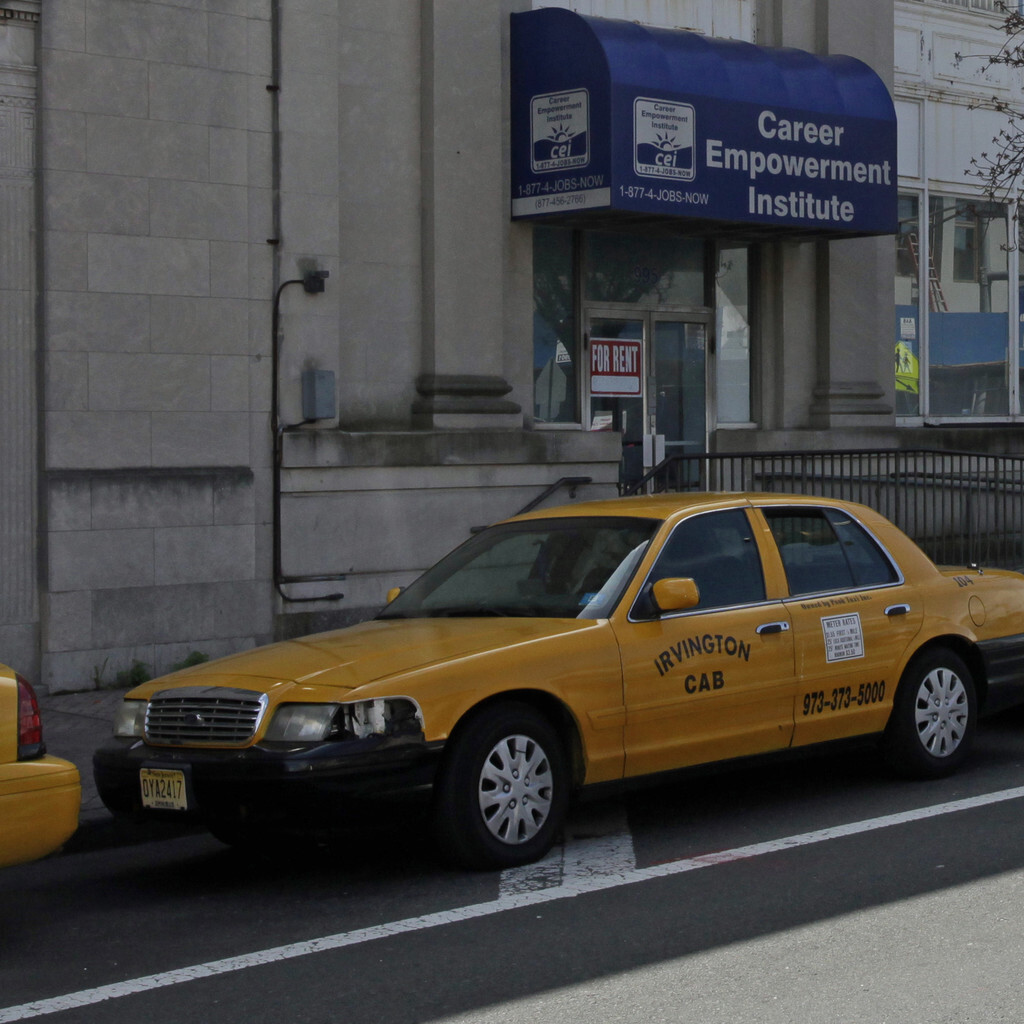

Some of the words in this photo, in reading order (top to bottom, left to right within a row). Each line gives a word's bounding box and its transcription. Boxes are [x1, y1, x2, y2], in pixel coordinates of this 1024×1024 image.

[537, 102, 582, 115] Empowerment
[548, 96, 570, 105] Career
[653, 104, 676, 113] Career
[546, 113, 572, 123] Institute
[641, 110, 688, 123] Empowerment
[651, 121, 678, 131] Institute
[758, 110, 844, 146] Career
[550, 139, 572, 159] cei
[655, 150, 677, 168] cei
[639, 166, 691, 178] 1-877-4-JOBS-NOW
[706, 139, 891, 186] Empowerment
[518, 175, 604, 196] 1-877-4-JOBS-NOW
[619, 184, 709, 205] 1-877-4-JOBS-NOW
[749, 186, 854, 222] Institute
[592, 344, 610, 372] FOR
[612, 345, 638, 373] RENT
[826, 620, 842, 628] METER
[842, 617, 856, 626] RATES
[654, 634, 751, 677] IRVINGTON
[684, 670, 725, 694] CAB
[803, 679, 886, 716] 973-373-5000
